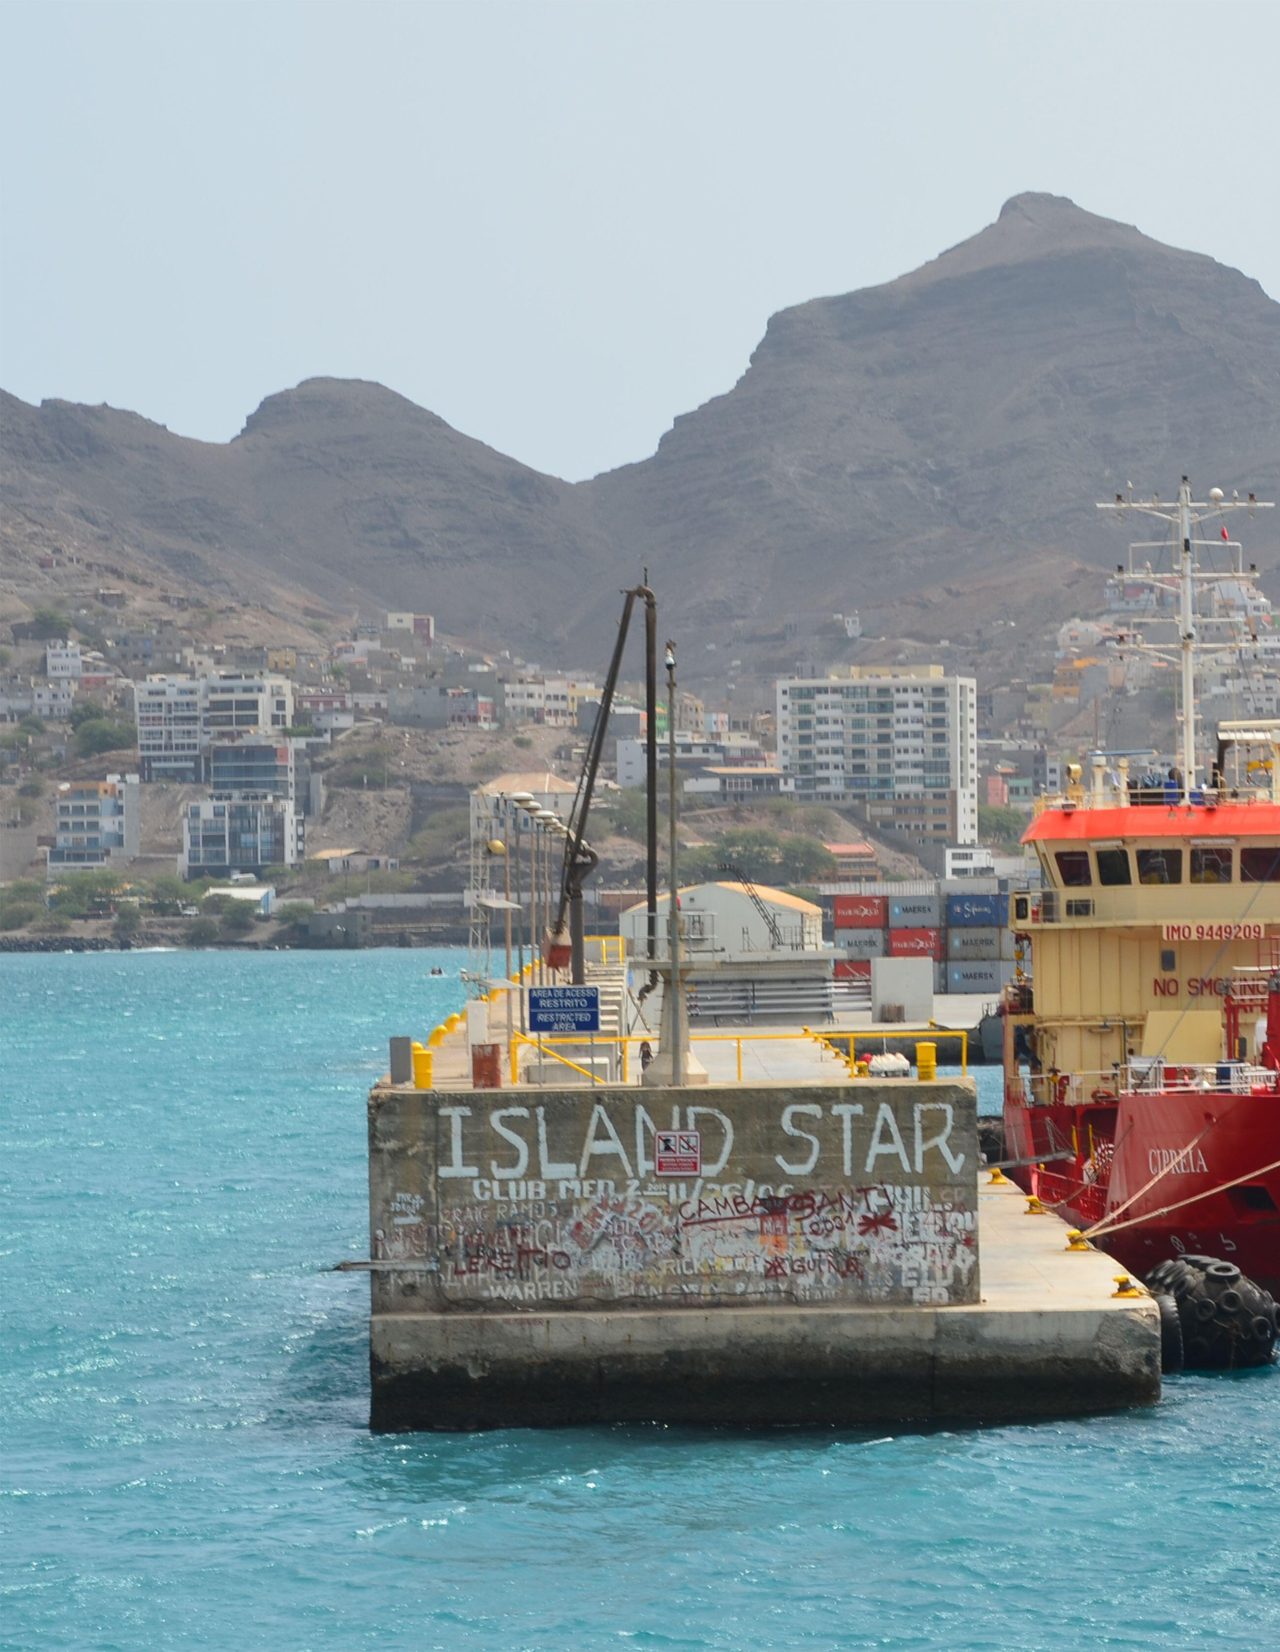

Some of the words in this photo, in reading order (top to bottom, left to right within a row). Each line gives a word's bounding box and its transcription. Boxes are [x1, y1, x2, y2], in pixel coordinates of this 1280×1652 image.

[902, 906, 932, 914] MAERSK
[1166, 925, 1191, 940] IMO
[1196, 925, 1262, 940] 9449209
[565, 989, 597, 998] ACESSO
[1153, 979, 1180, 997] NO
[539, 998, 588, 1008] RESTRITO
[537, 1012, 592, 1022] RESTRICTED
[552, 1022, 577, 1031] AREA
[436, 1104, 735, 1180] ISLAND
[773, 1103, 966, 1176] STAR
[473, 1179, 546, 1201] CLUB
[559, 1179, 616, 1200] MED
[489, 1278, 578, 1301] WARREN
